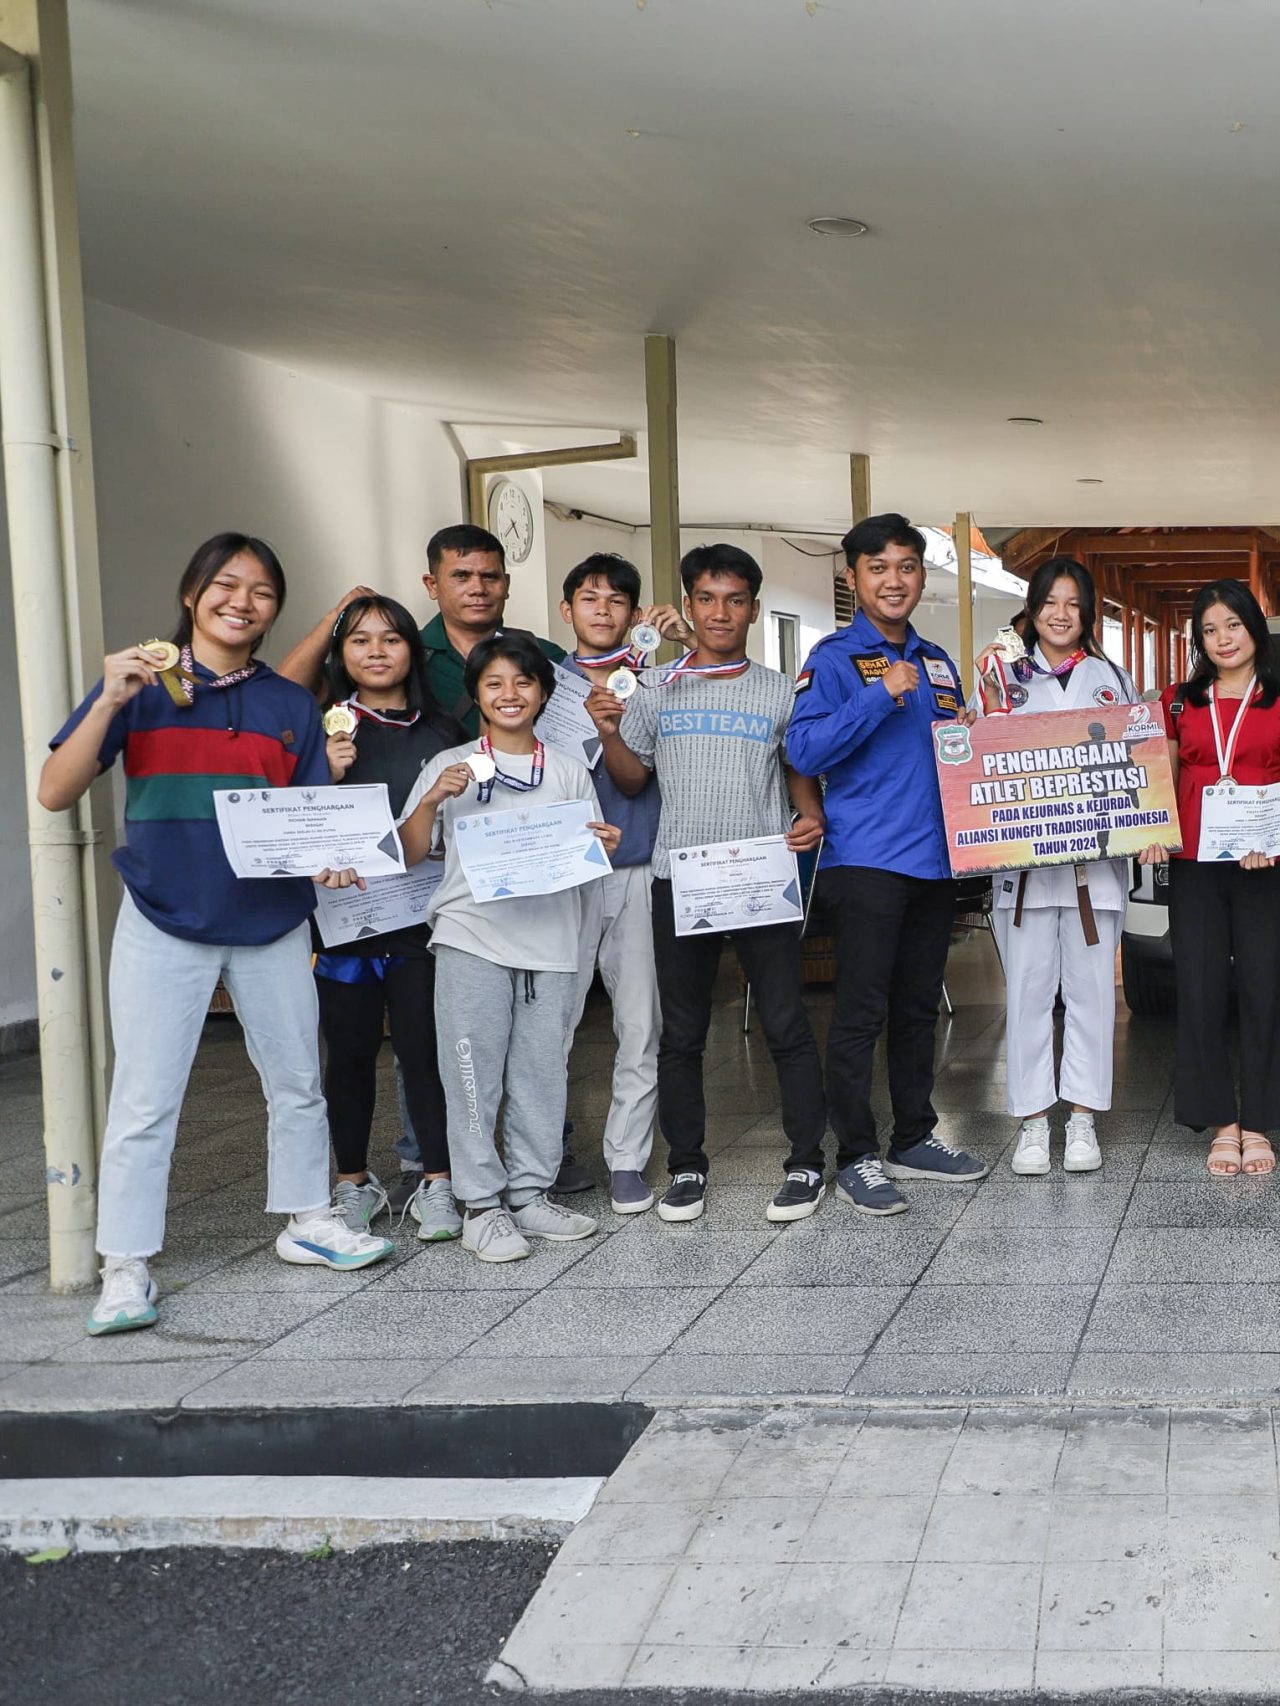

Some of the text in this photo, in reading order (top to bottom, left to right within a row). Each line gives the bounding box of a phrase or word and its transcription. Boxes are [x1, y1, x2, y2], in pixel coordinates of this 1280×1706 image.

[660, 713, 769, 738] BEST TEAM
[1128, 723, 1158, 732] KORMI
[982, 741, 1128, 776] PENGHARGAAN
[971, 767, 1148, 806] ATLET BEPRESTASI
[992, 797, 1131, 823] PADA KEJURNAS & KEJURDA
[957, 811, 1169, 846] ALIANSI KUNGFU TRADISIONAL INDONESIA
[1033, 837, 1097, 856] TAHUN 2024
